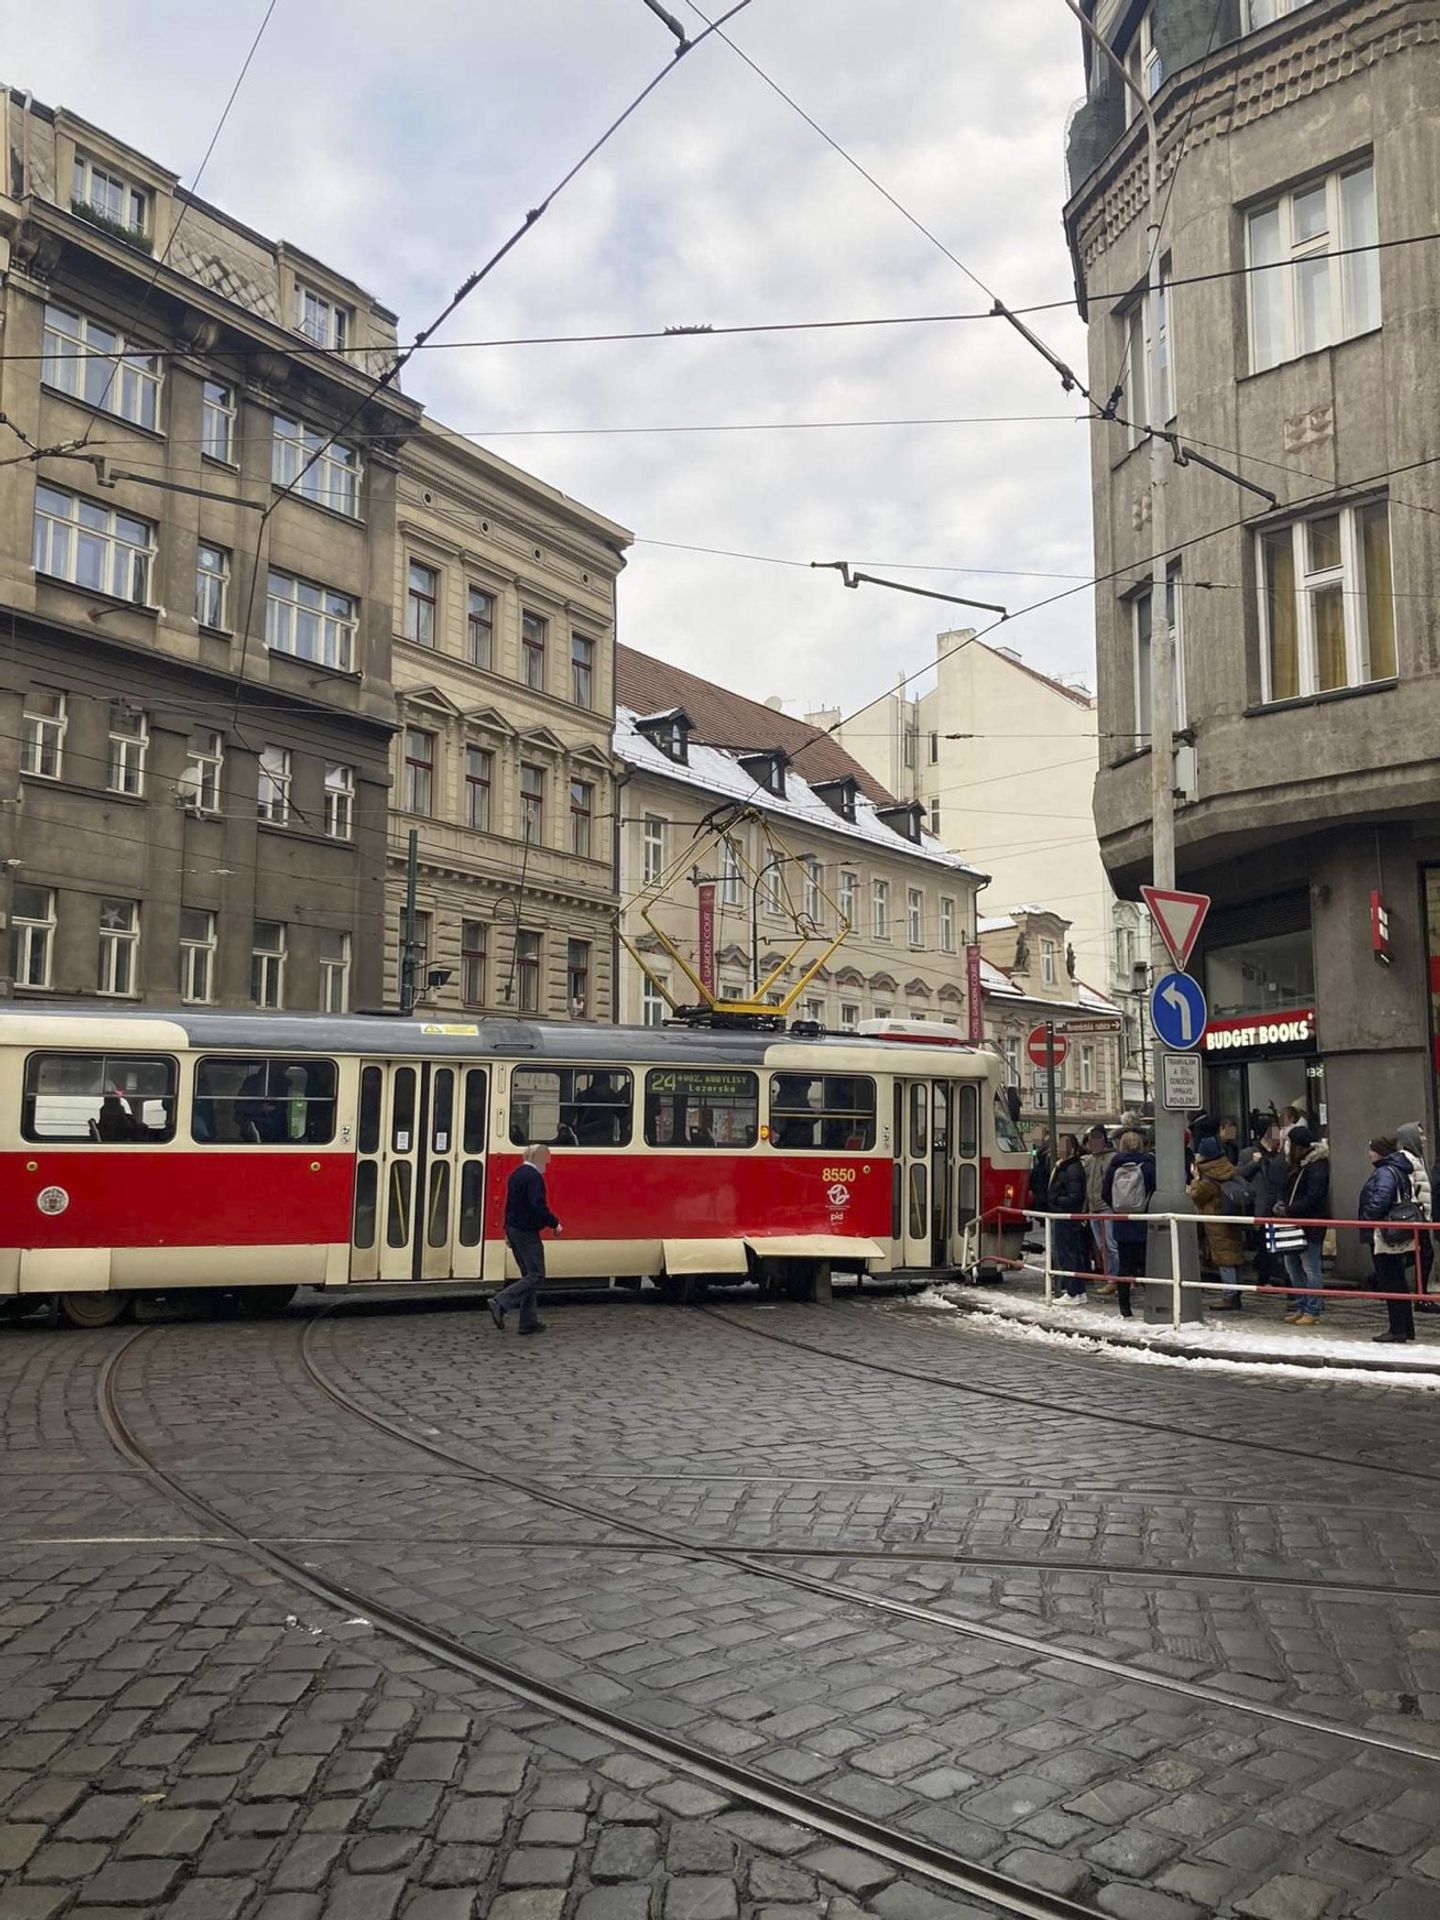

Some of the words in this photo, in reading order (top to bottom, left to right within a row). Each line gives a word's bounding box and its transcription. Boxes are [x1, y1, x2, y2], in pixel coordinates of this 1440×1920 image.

[704, 942, 712, 978] GARDEN
[1206, 1027, 1257, 1050] BUDGET
[1259, 1020, 1309, 1045] BOOKS
[652, 1073, 676, 1091] 24
[822, 1168, 856, 1182] 8550
[831, 1212, 844, 1221] pid
